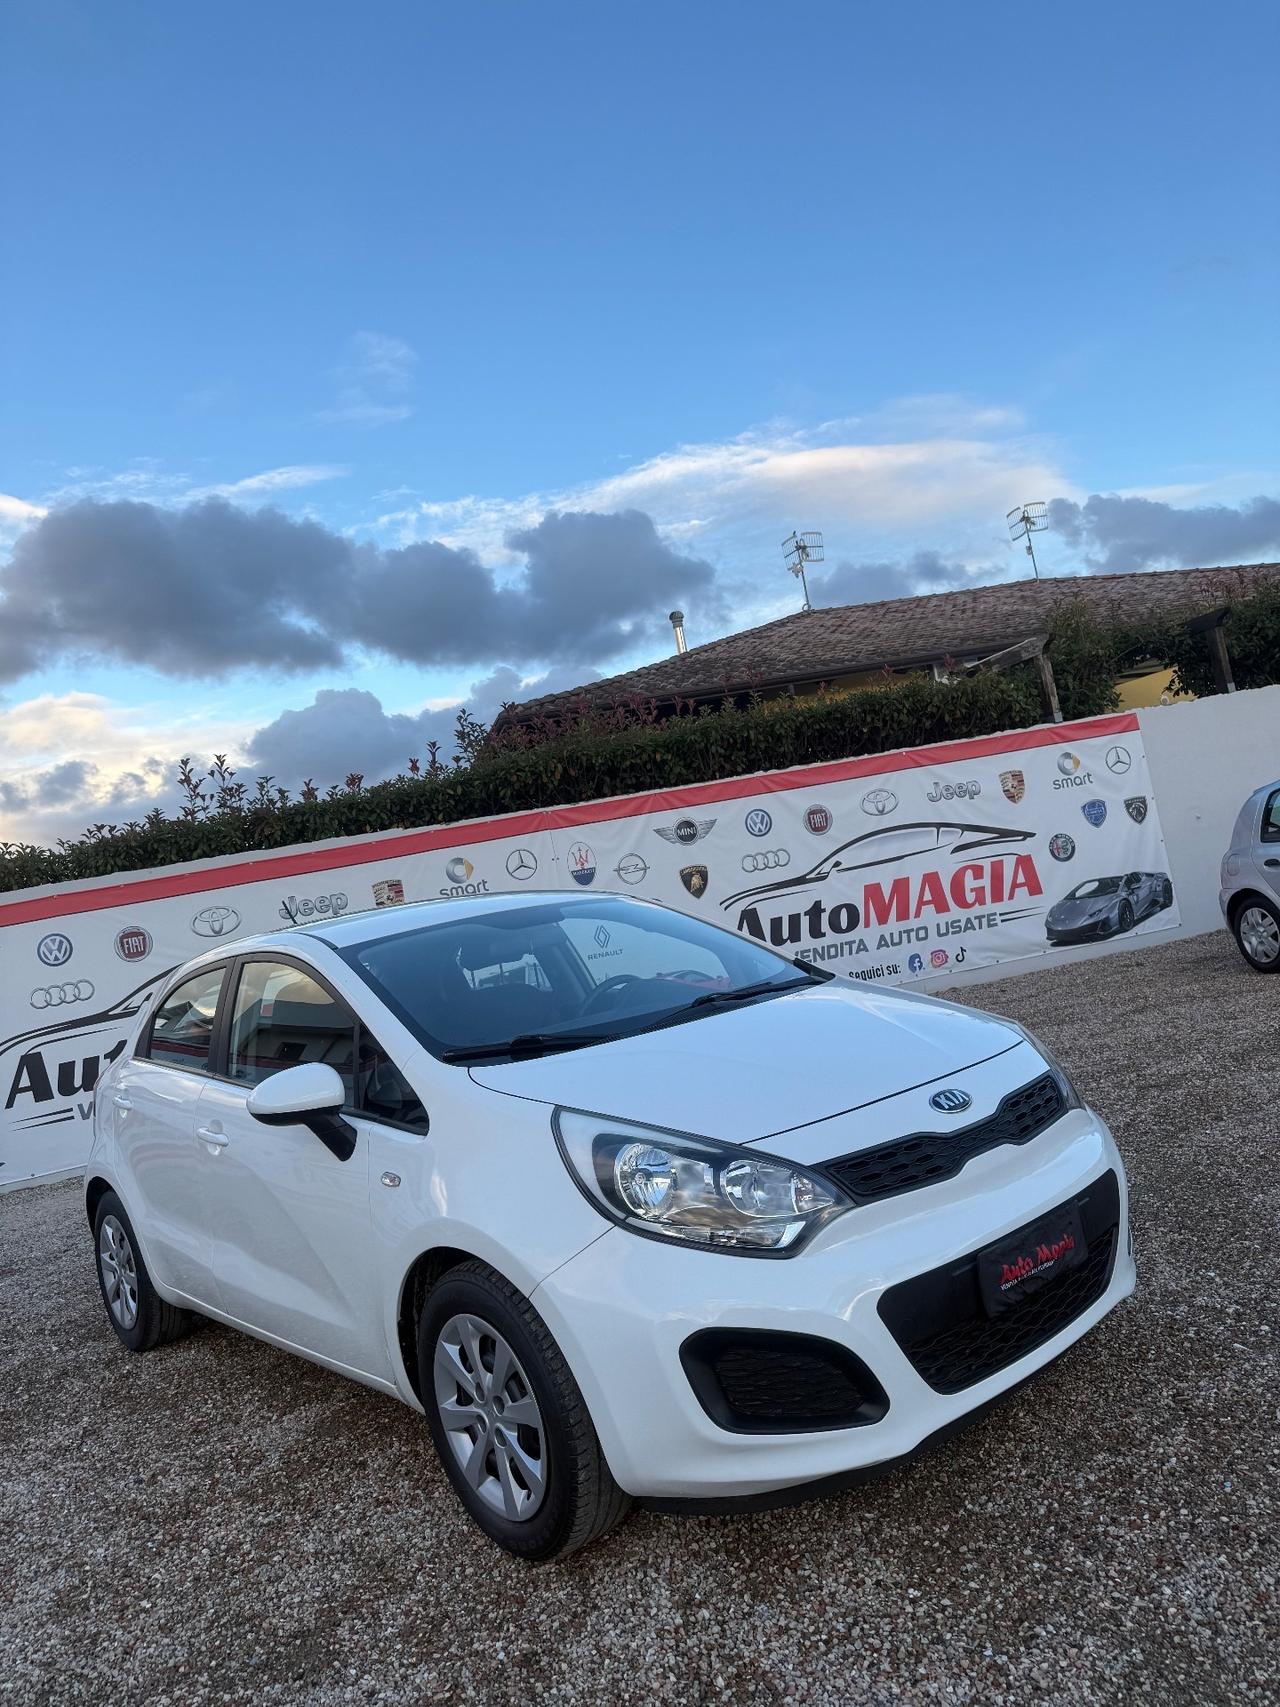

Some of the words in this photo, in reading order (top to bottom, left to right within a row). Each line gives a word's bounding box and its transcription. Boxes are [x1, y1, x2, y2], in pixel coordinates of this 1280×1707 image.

[1052, 773, 1094, 790] smart
[927, 780, 981, 802] Jeep
[809, 812, 827, 828] FIAT
[677, 827, 696, 837] MINI
[278, 892, 348, 919] Jeep
[123, 936, 145, 955] FIAT
[795, 938, 869, 964] ENDITA
[876, 925, 928, 951] AUTO
[937, 911, 998, 937] USATE
[587, 949, 623, 961] RENAULT
[887, 963, 902, 977] su:
[936, 1092, 968, 1110] KIA
